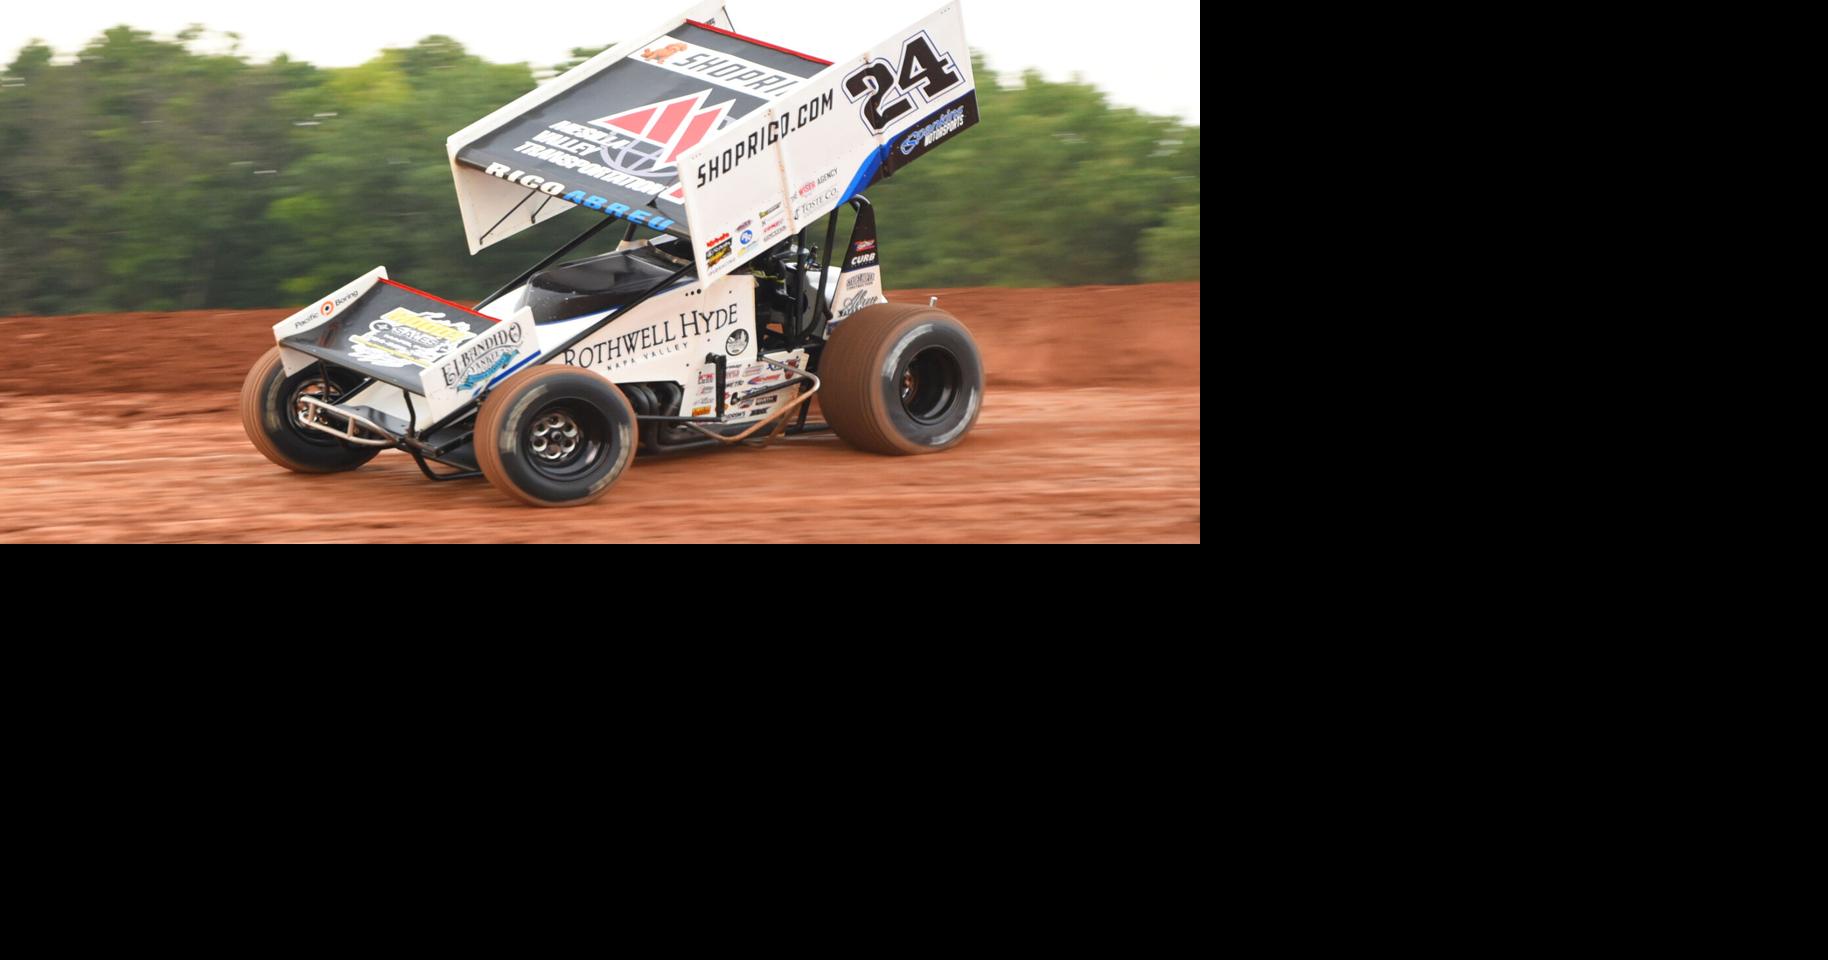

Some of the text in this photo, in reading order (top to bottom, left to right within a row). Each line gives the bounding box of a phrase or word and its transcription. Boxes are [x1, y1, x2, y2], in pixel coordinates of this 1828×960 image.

[843, 34, 962, 132] 24
[532, 130, 602, 156] VALLEY
[549, 120, 631, 150] MESILLA
[696, 88, 834, 189] SHOPRICO.COM
[513, 141, 669, 195] TRANSPORTATION
[817, 167, 838, 185] AGENCY
[485, 162, 675, 231] RICO ABREU
[851, 252, 876, 266] CURB
[335, 290, 359, 306] Boring
[461, 322, 521, 367] BANDIDO
[564, 303, 738, 368] ROTHWELL HYDE
[606, 341, 689, 371] NAPA VALLEY
